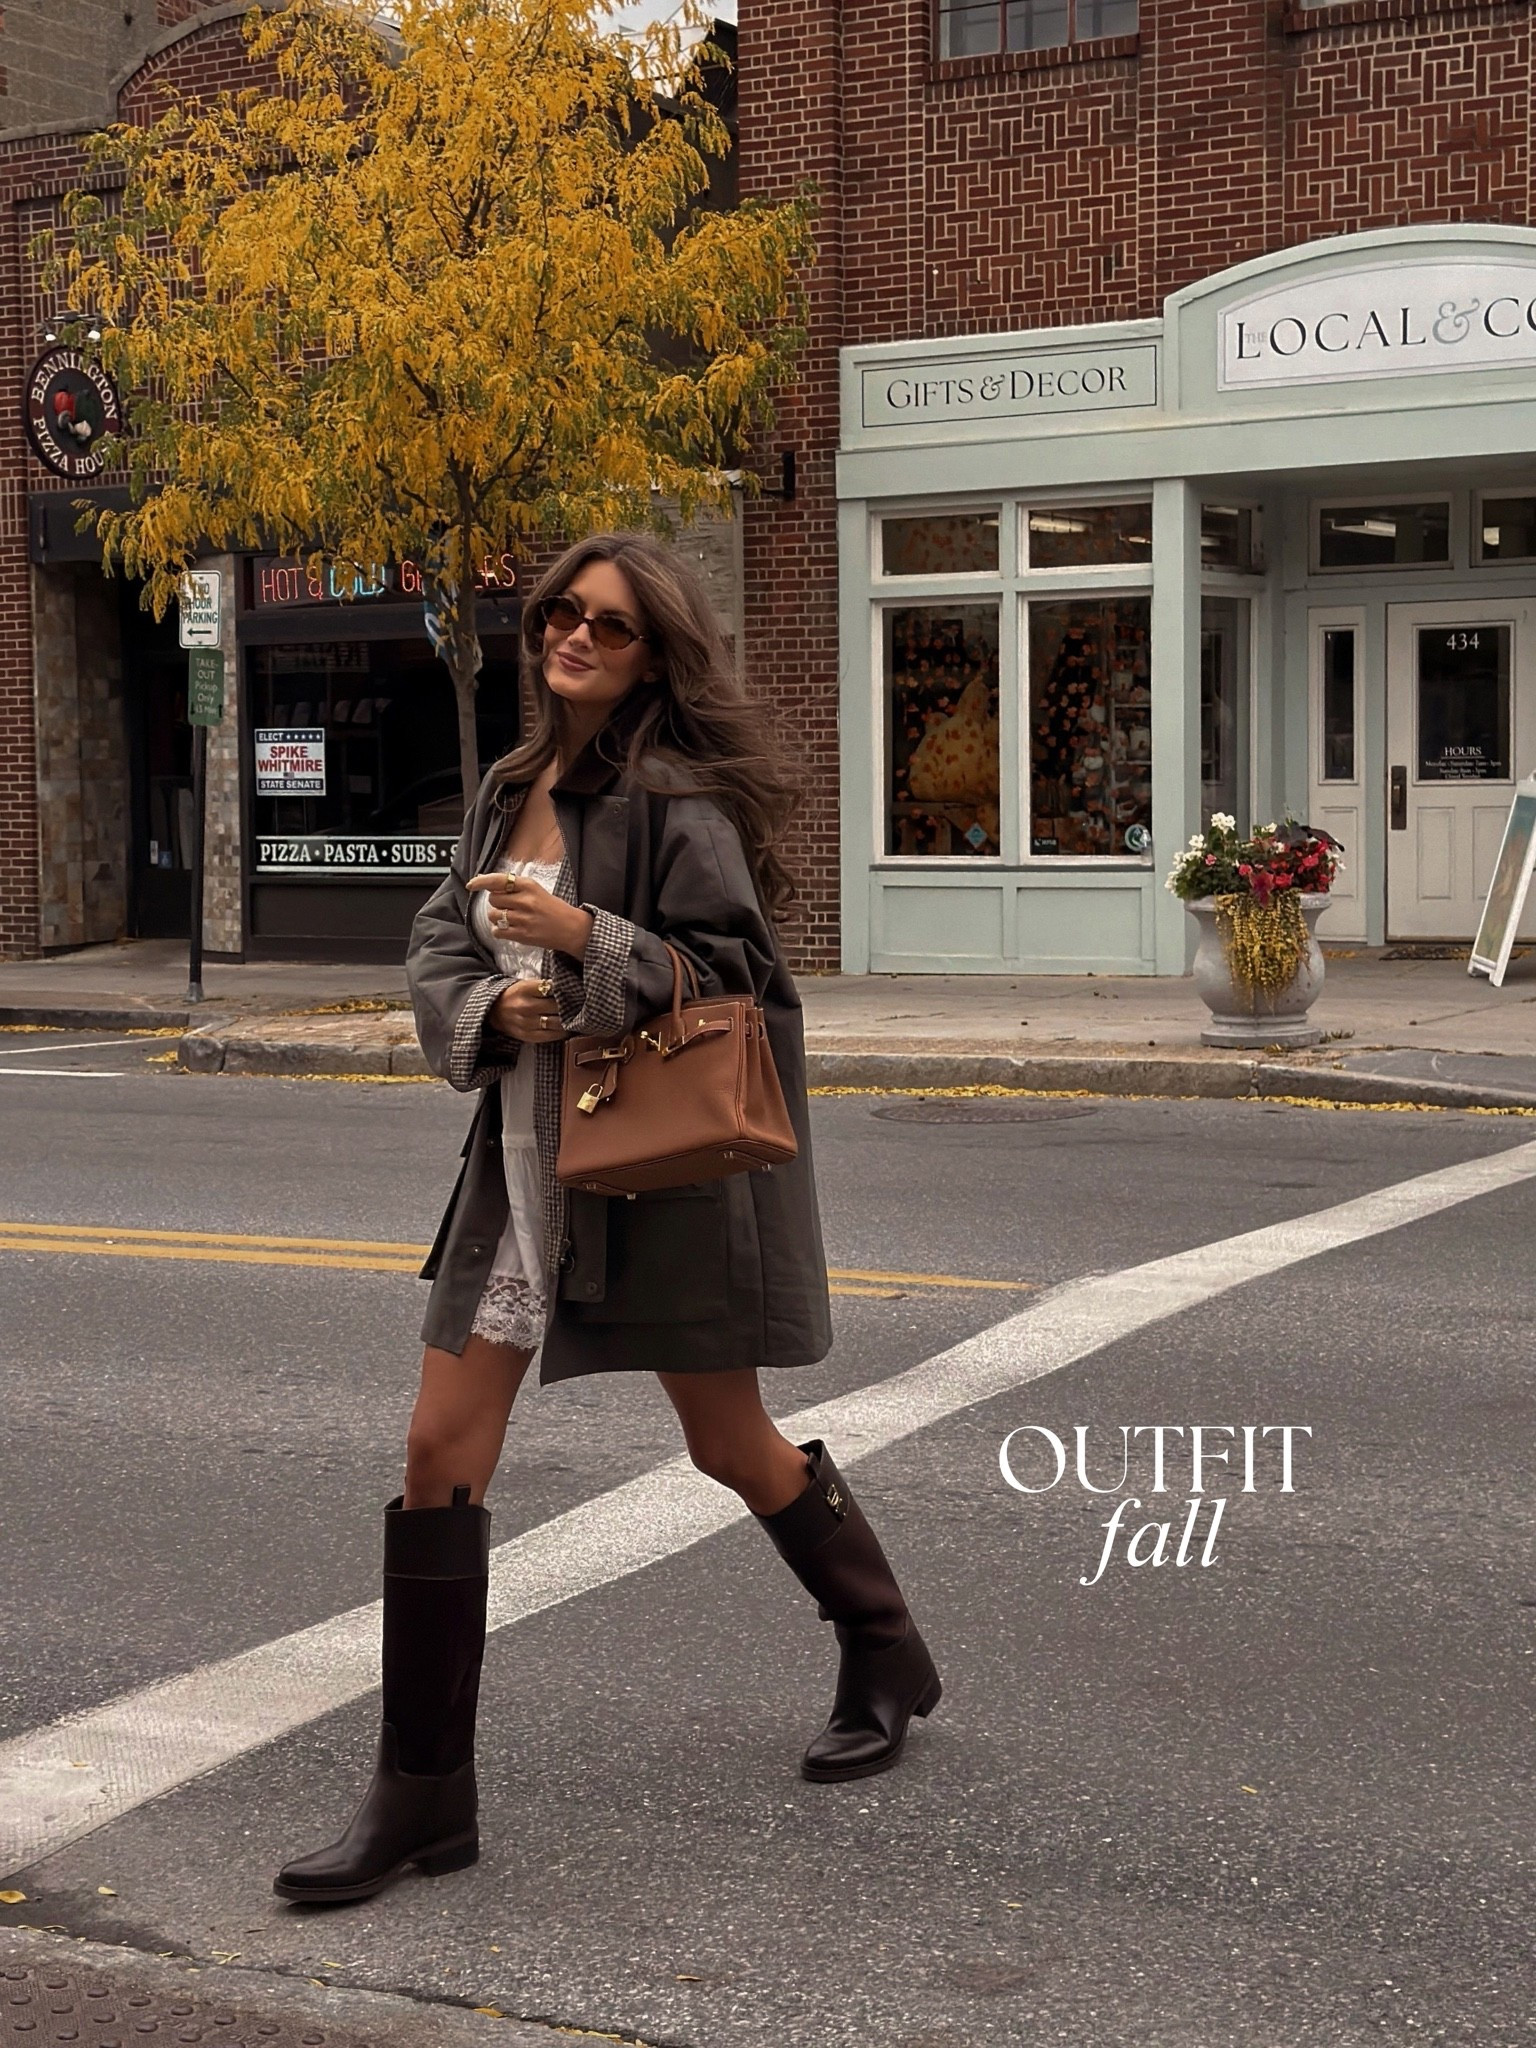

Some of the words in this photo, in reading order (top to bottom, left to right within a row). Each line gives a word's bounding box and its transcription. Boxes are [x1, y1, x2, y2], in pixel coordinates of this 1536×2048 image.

[1236, 307, 1427, 360] LOCAL
[1432, 298, 1480, 345] &
[1483, 296, 1536, 338] C
[886, 378, 974, 409] GIFTS
[979, 374, 1006, 401] &
[1010, 366, 1127, 400] DECOR
[33, 416, 69, 472] PIZZA
[261, 567, 304, 602] HOT
[182, 612, 218, 624] PARKING
[1446, 632, 1480, 650] 434
[197, 669, 216, 680] OUT
[258, 732, 284, 742] ELECT
[270, 745, 309, 758] SPIKE
[1444, 746, 1482, 757] HOURS
[257, 759, 323, 772] WHITMIRE
[260, 779, 285, 789] STATE
[286, 779, 322, 789] SENATE
[260, 843, 312, 863] PIZZA
[323, 843, 380, 863] PASTA
[391, 843, 437, 863] SUBS
